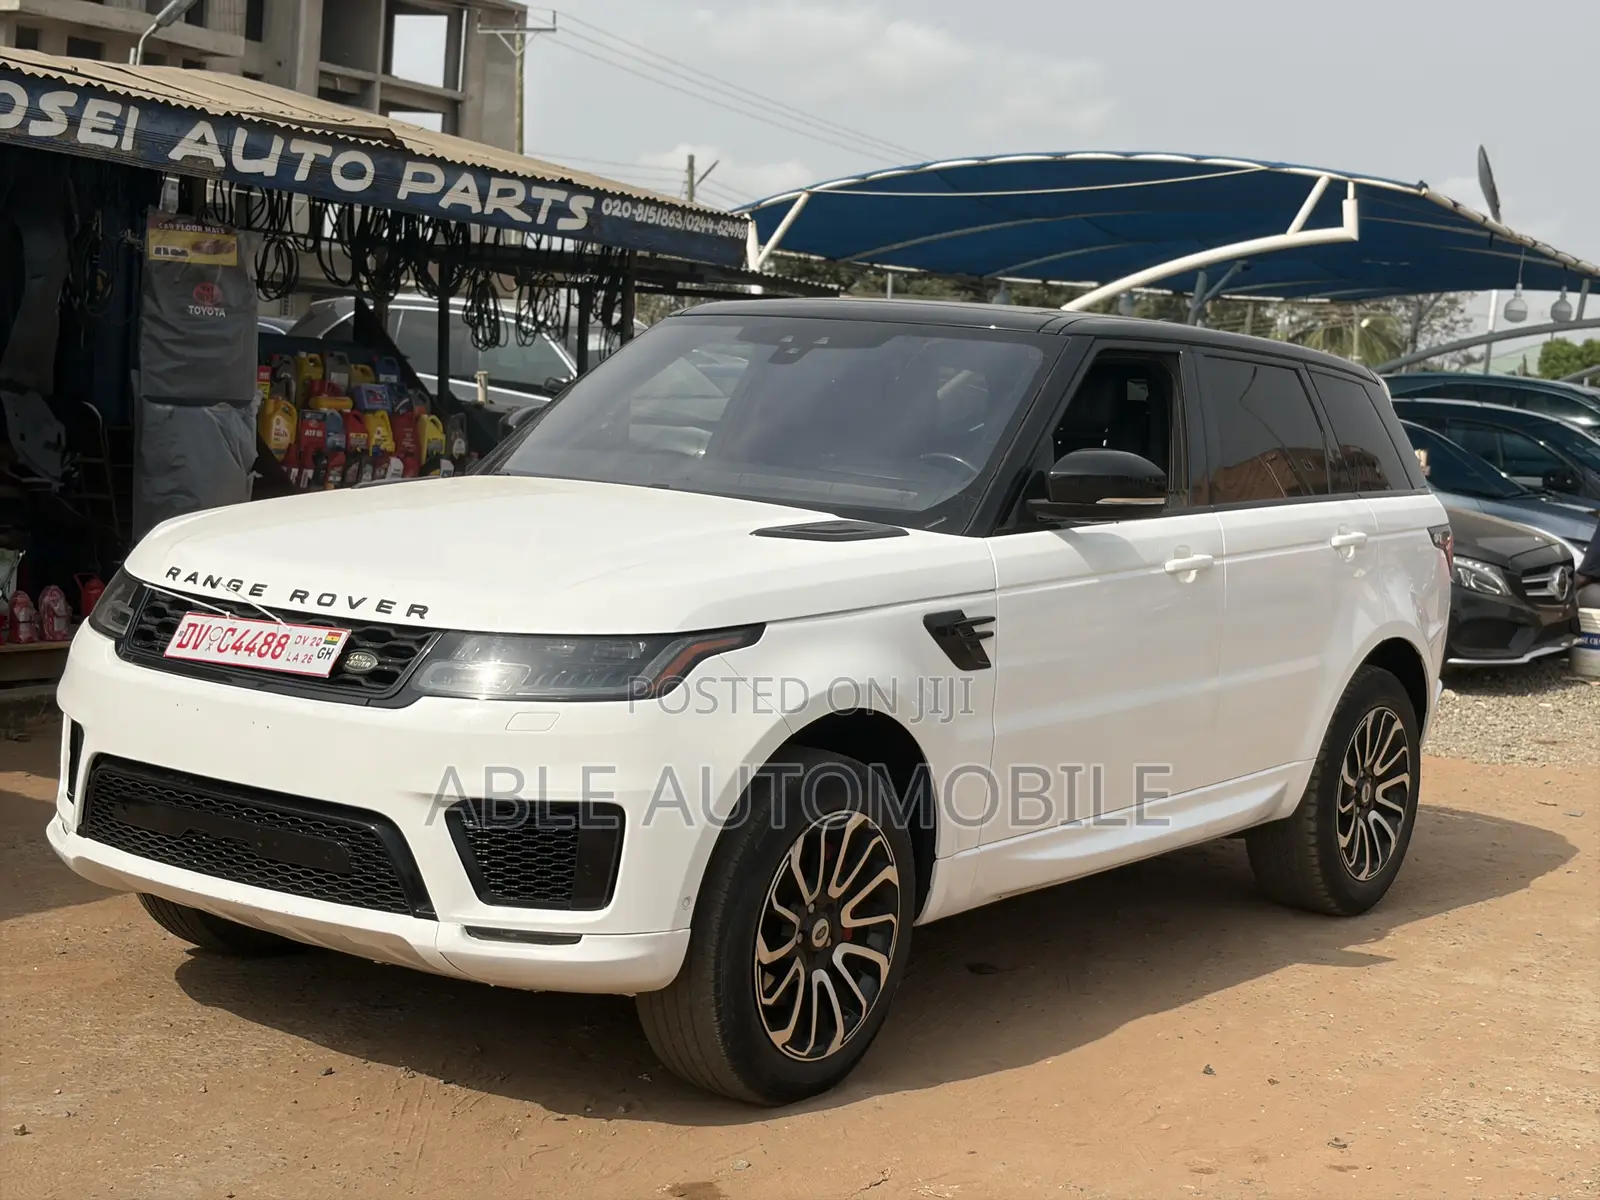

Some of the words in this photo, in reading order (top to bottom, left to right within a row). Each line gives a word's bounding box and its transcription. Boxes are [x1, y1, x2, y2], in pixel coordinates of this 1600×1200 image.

[0, 79, 140, 151] OSEI
[168, 121, 375, 192] AUTO
[396, 161, 596, 231] PARTS
[175, 223, 203, 232] FLOOR
[188, 305, 226, 318] TOYOTA
[165, 566, 268, 598] RANGE
[289, 588, 430, 620] ROVER
[176, 622, 212, 650] DV
[216, 627, 291, 660] C4488
[294, 635, 309, 645] DV
[310, 637, 323, 647] 20
[286, 652, 300, 662] LA
[301, 654, 314, 664] 26
[316, 646, 335, 660] GH
